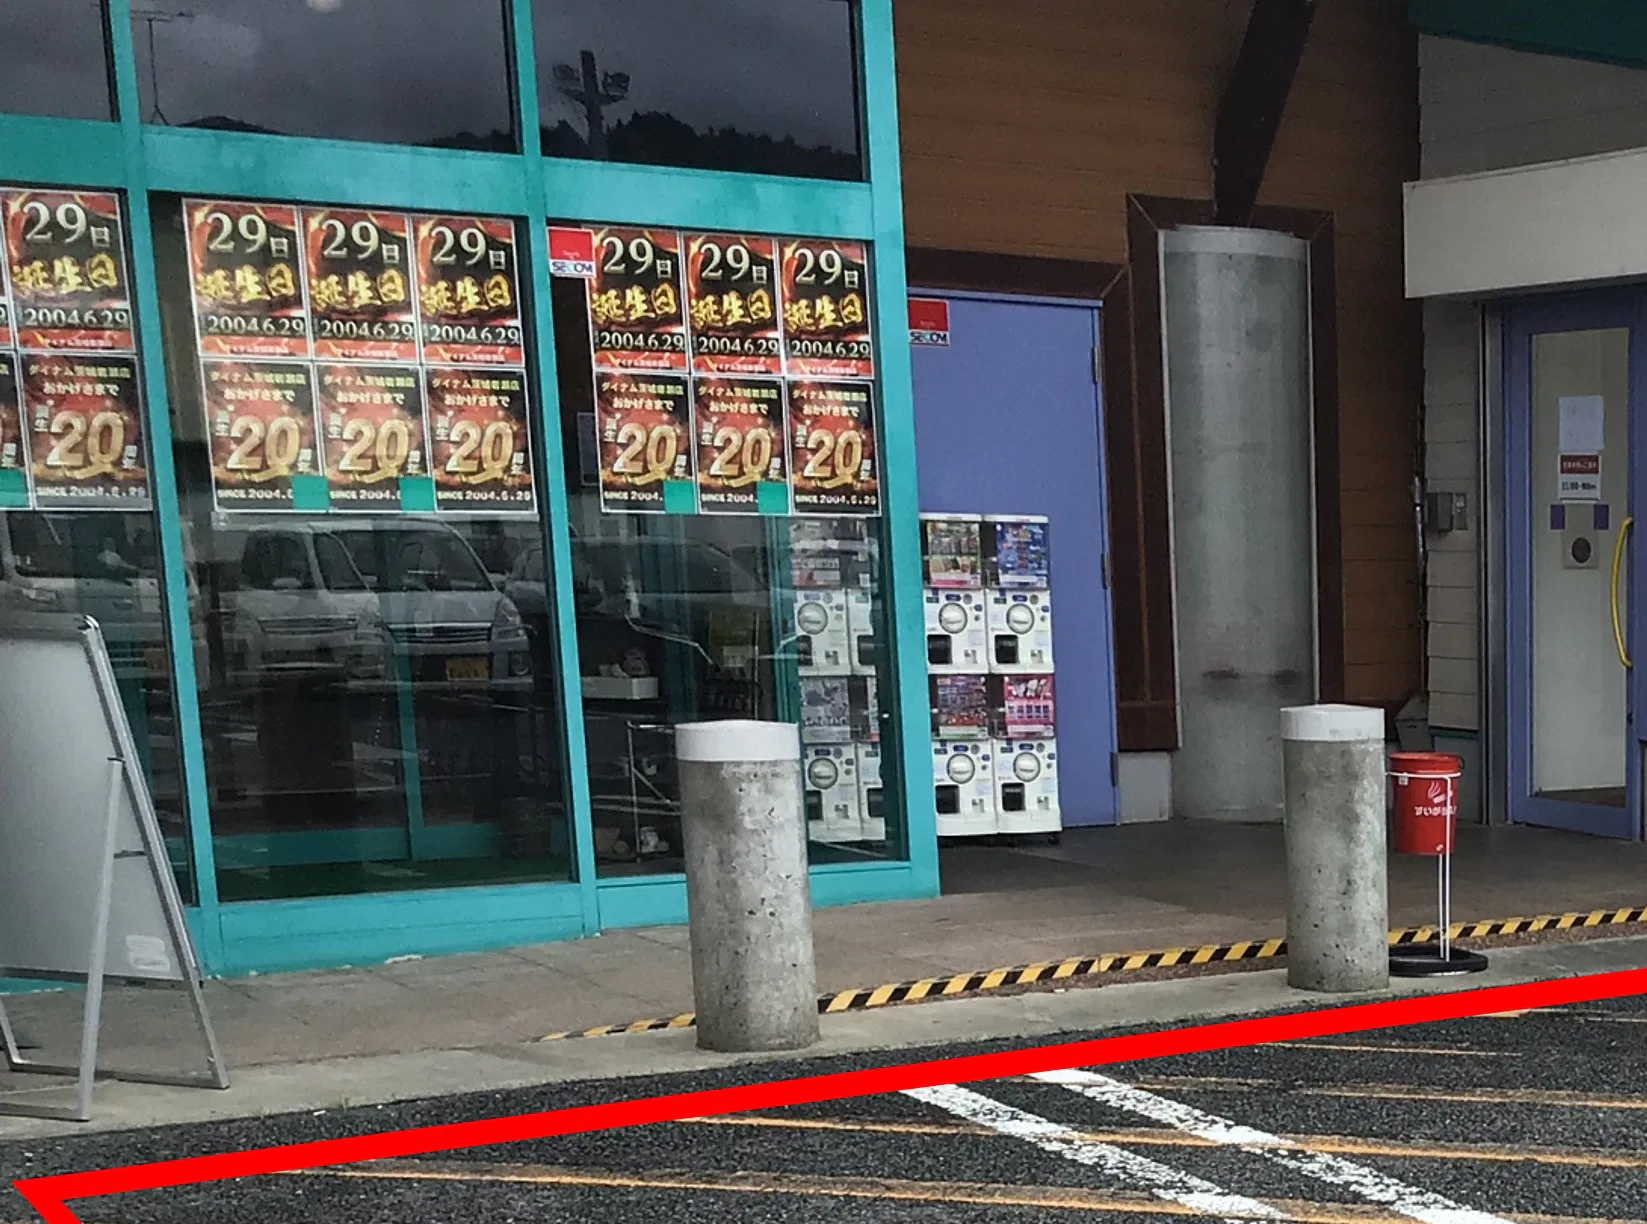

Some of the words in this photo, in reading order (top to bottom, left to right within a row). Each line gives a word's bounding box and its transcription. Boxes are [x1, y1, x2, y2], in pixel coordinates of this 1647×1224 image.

[23, 201, 110, 247] 29日
[207, 212, 288, 258] 29日
[322, 219, 399, 263] 29日
[431, 226, 505, 270] 29日
[602, 236, 672, 279] 29日
[701, 243, 767, 284] 29日
[795, 248, 858, 289] 29日
[47, 410, 125, 468] 20
[227, 415, 300, 470] 20
[339, 419, 409, 471] 20
[446, 420, 514, 472] 20
[613, 422, 677, 473] 20
[710, 426, 771, 477] 20
[804, 429, 862, 478] 20
